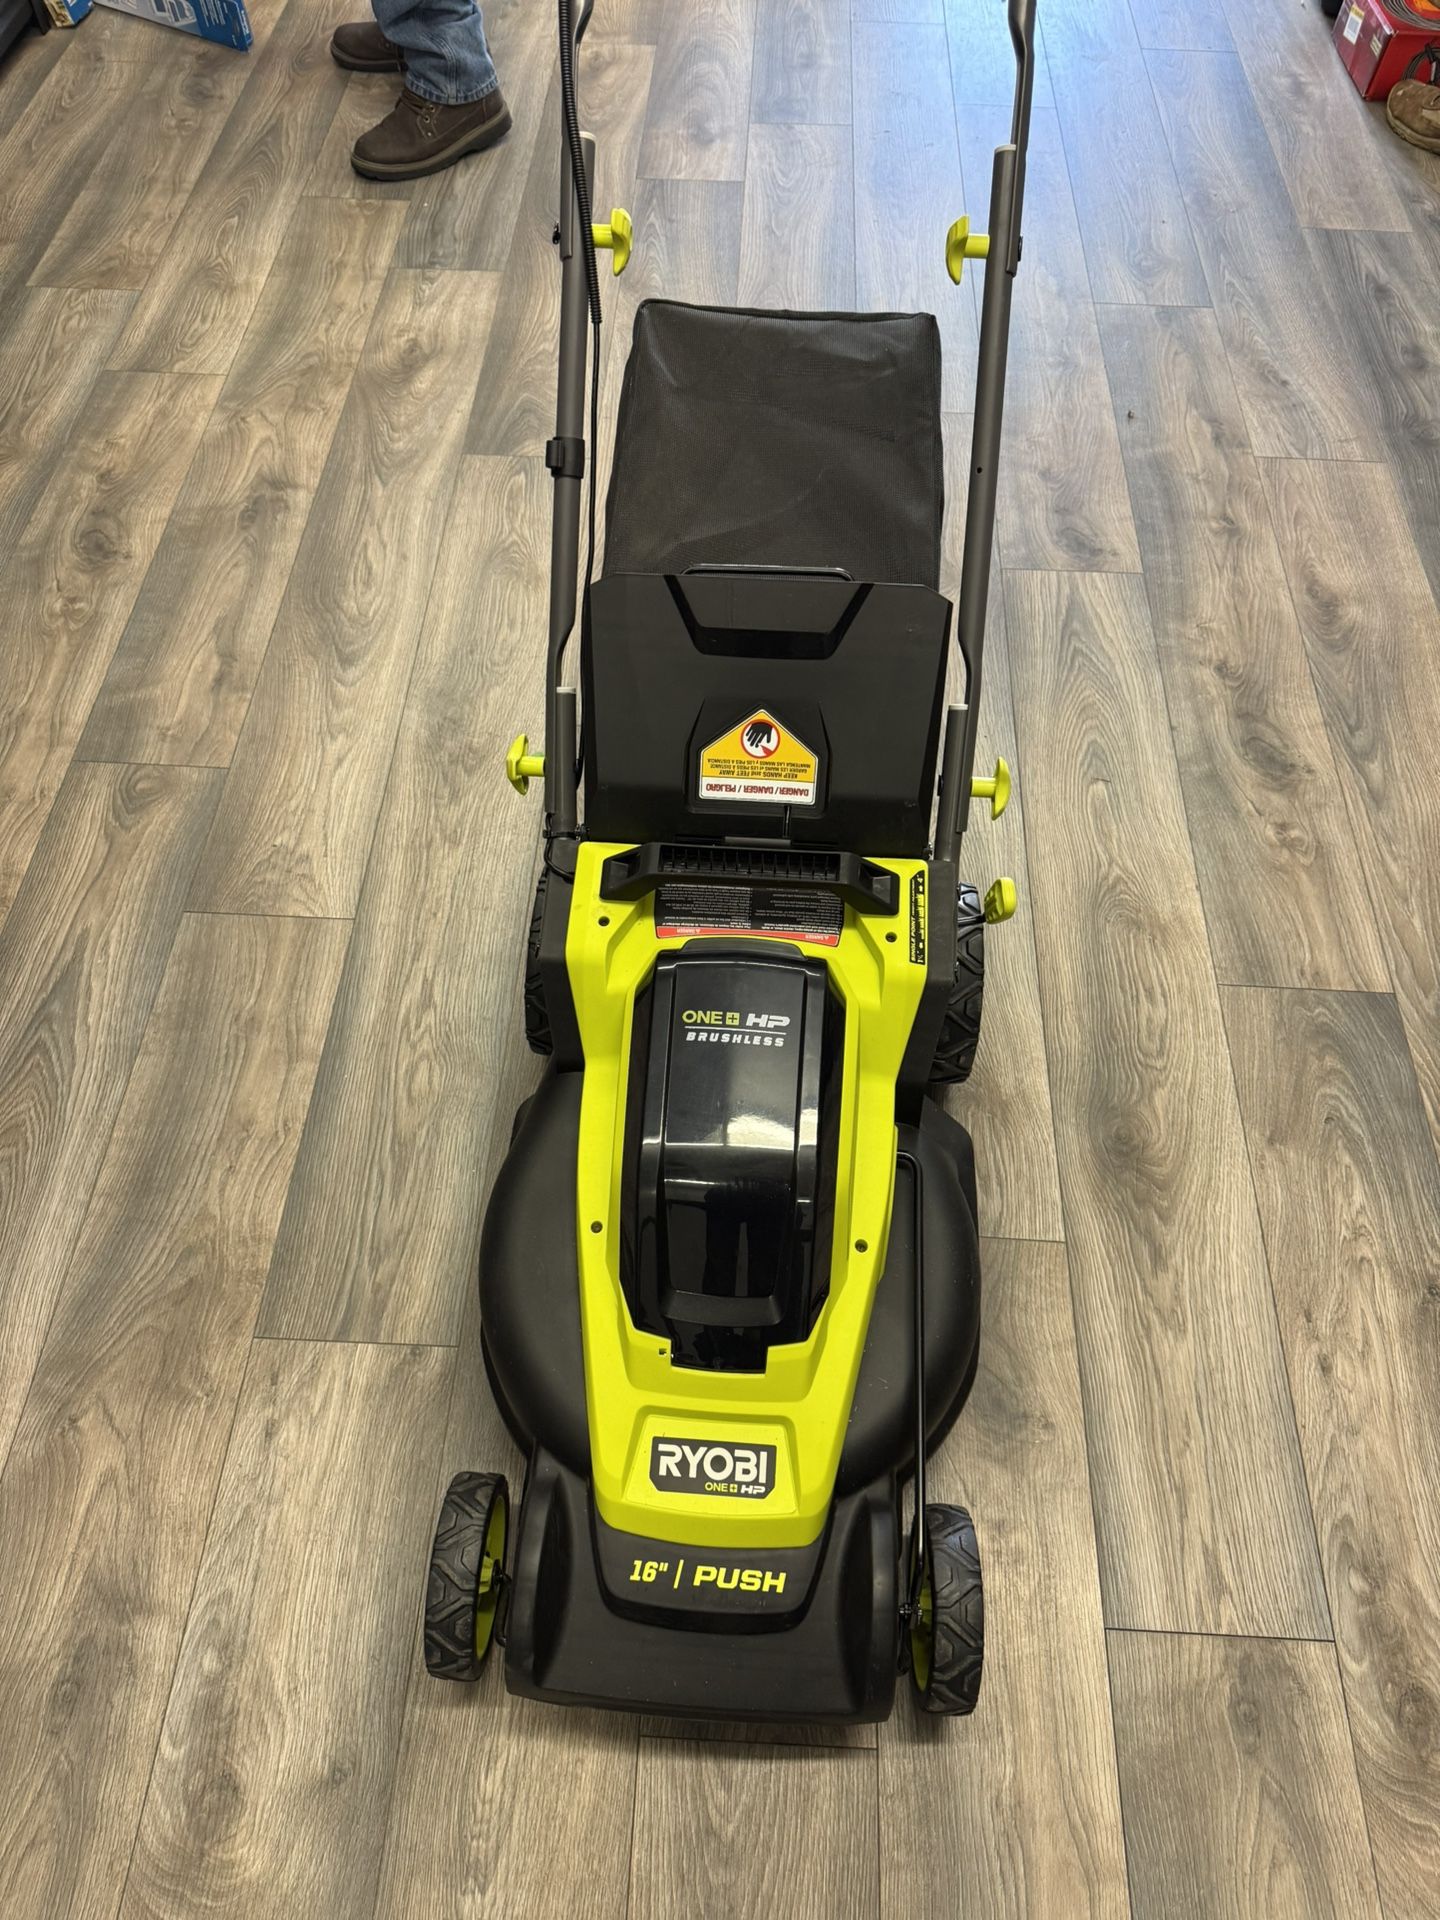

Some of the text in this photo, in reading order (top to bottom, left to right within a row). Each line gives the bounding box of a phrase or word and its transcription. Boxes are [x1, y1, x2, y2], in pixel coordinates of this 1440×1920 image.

[706, 783, 736, 792] PELIGRO
[744, 785, 774, 794] DANGER
[780, 787, 809, 797] DANGER
[746, 1013, 790, 1028] HP
[686, 1031, 784, 1047] BRUSHLESS
[658, 1443, 767, 1484] RYOBI
[740, 1484, 766, 1495] HP
[629, 1559, 669, 1583] 16"
[693, 1565, 787, 1593] PUSH
